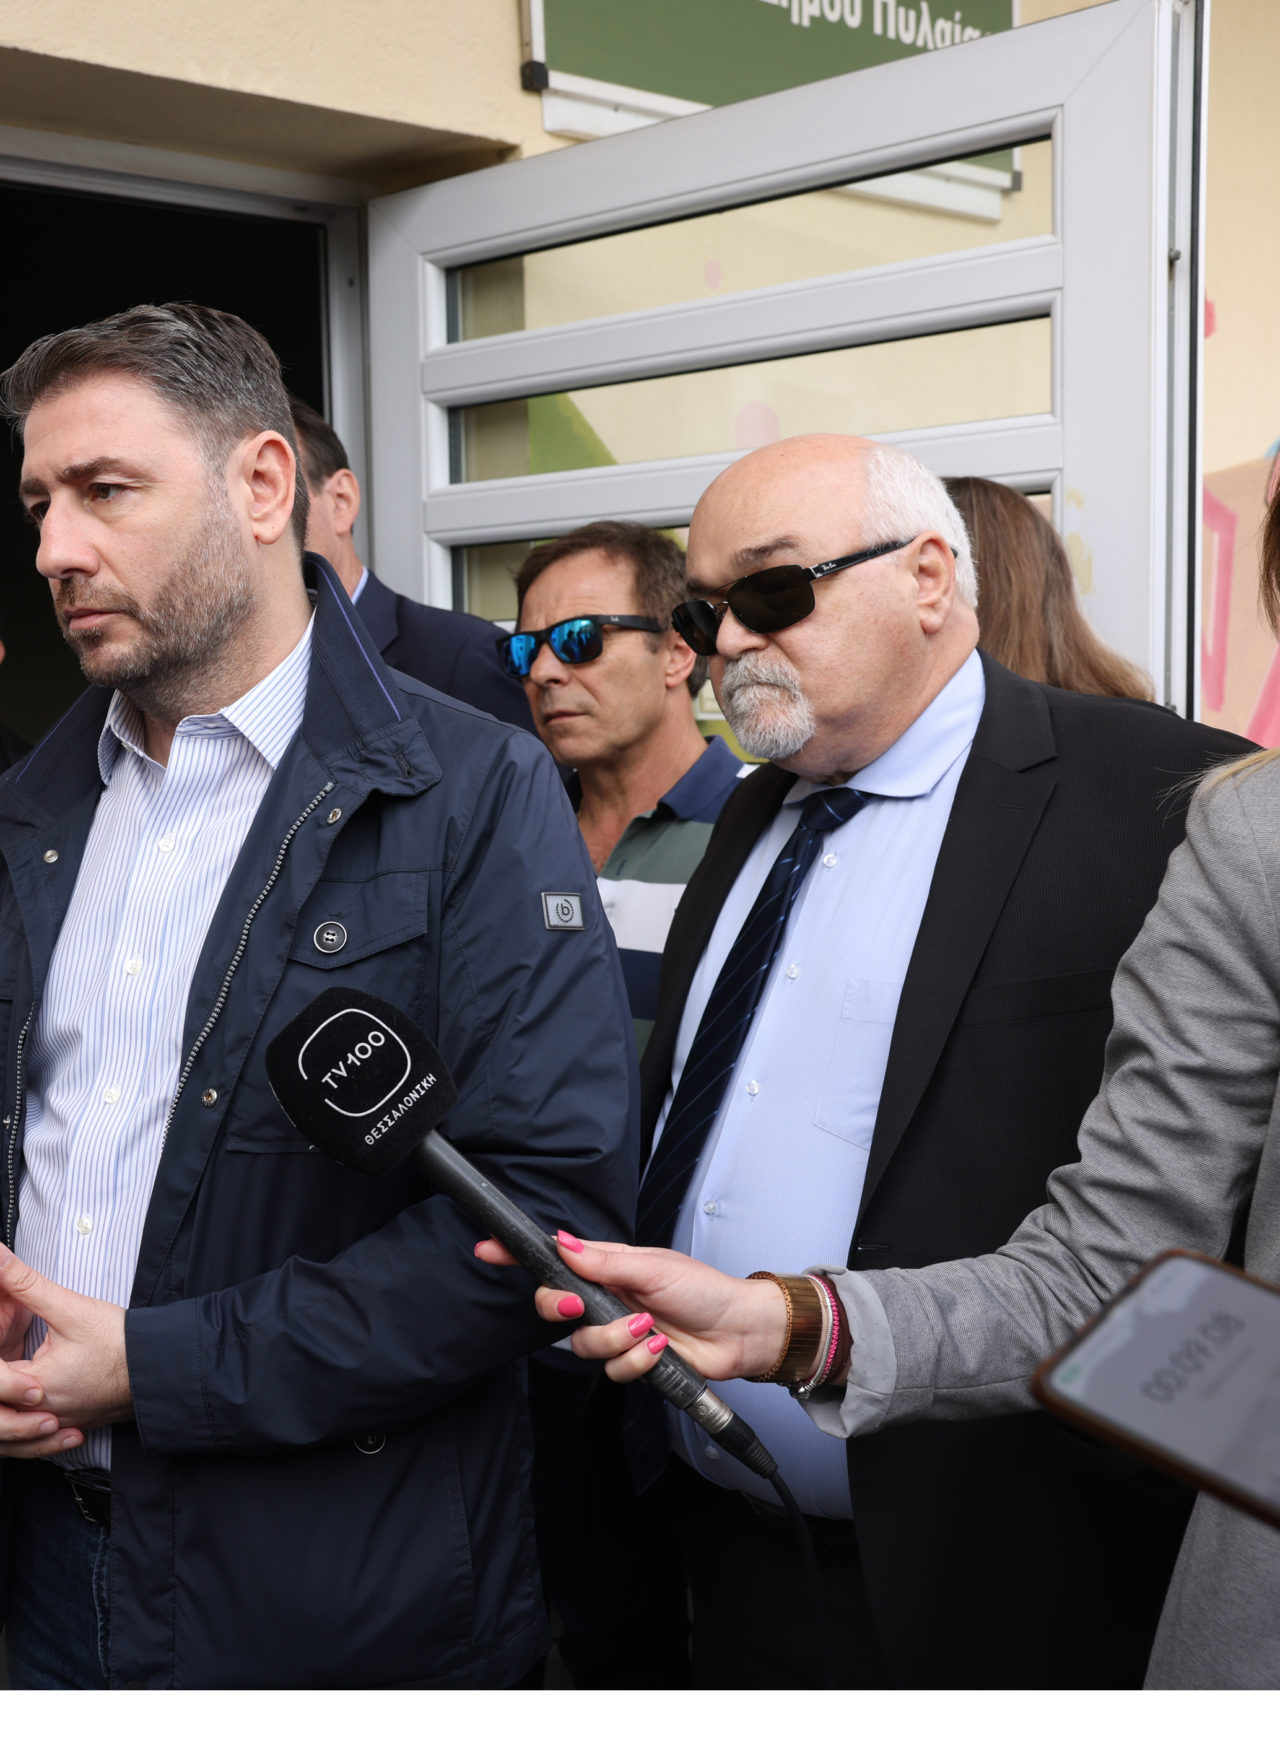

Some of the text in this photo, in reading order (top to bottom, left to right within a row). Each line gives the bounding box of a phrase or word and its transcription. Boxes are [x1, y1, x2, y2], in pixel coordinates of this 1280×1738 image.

[872, 0, 993, 49] Πυλαί
[321, 1031, 385, 1089] TV100
[364, 1073, 438, 1145] ΘΕΣΣΑΛΟΝΙΚΗ
